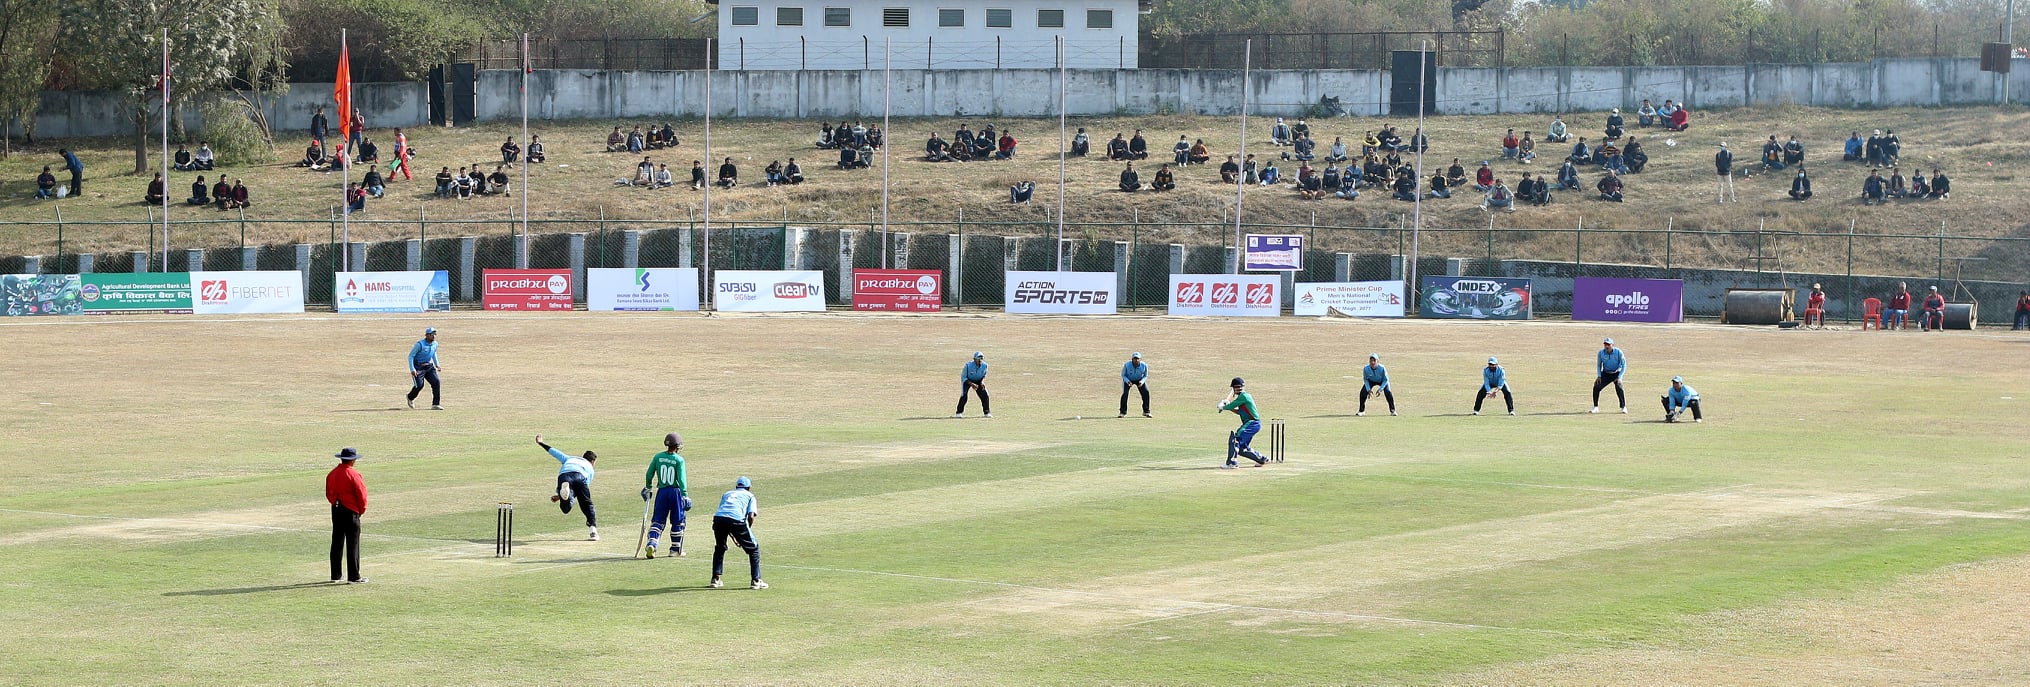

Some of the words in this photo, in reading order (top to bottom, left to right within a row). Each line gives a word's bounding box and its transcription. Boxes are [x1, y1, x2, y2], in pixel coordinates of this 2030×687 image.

[364, 282, 391, 292] HAMS
[775, 284, 806, 297] clear
[808, 283, 819, 296] tv
[1018, 281, 1055, 289] ACTION
[1368, 285, 1382, 293] Cup
[1457, 282, 1495, 292] INDEX
[232, 286, 291, 299] FIBERNET
[1013, 290, 1093, 304] SPORTS
[1605, 291, 1650, 308] apollo
[660, 464, 675, 486] 00
